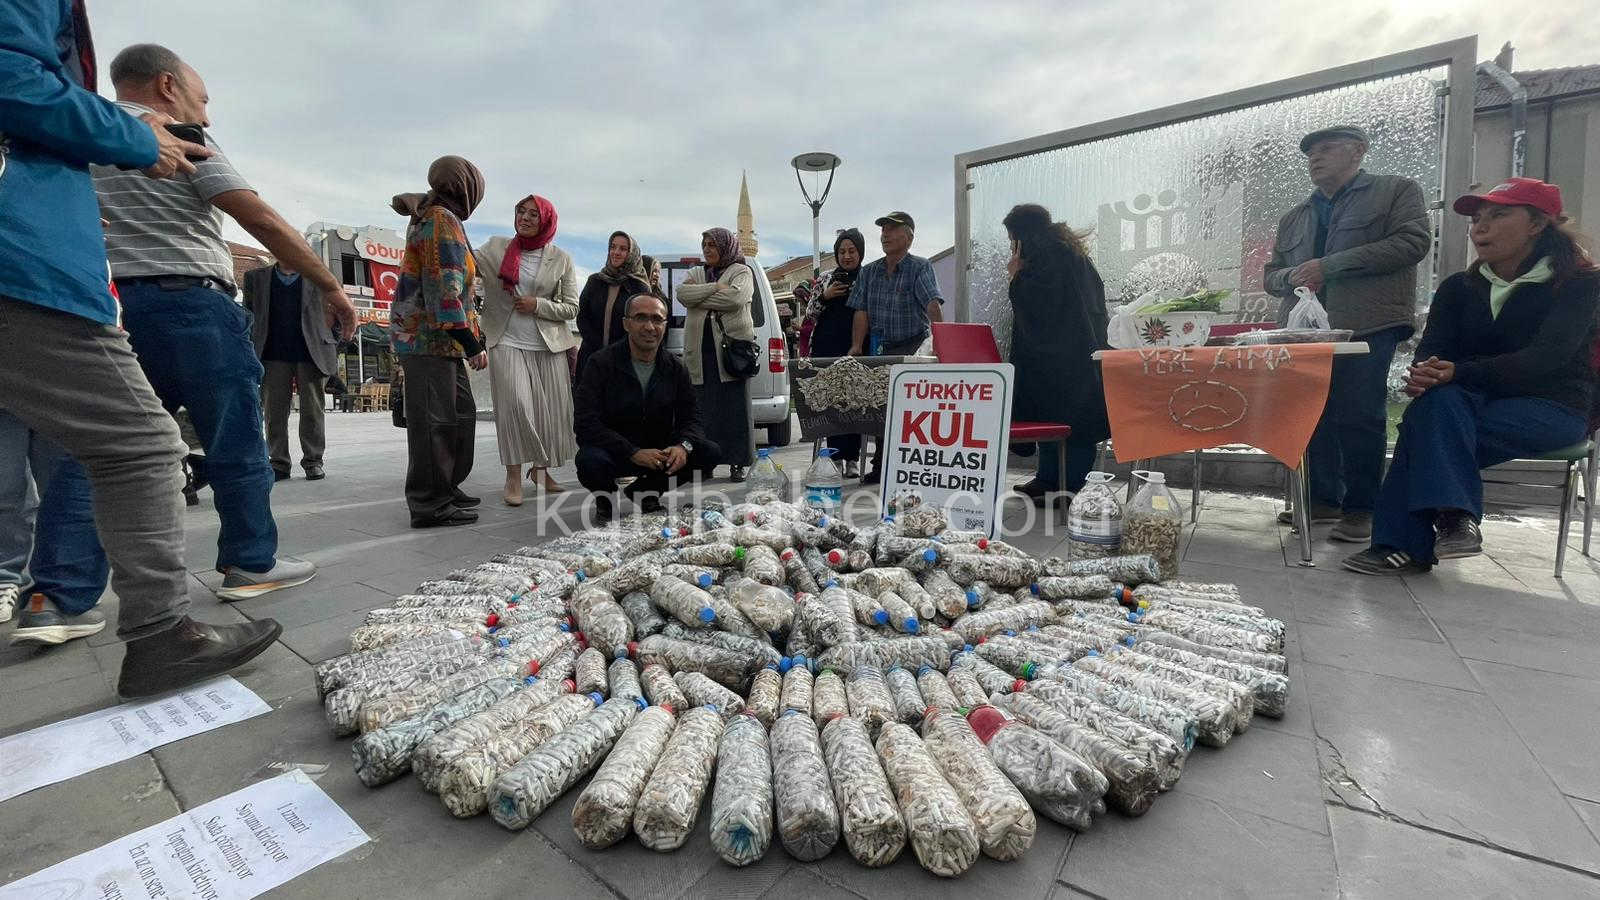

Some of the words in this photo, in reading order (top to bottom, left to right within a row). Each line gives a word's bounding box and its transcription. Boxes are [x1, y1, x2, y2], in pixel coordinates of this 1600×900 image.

[1138, 348, 1194, 374] YERE
[1212, 346, 1292, 371] ATMA
[903, 380, 993, 401] TÜRKİYE
[901, 403, 988, 449] KÜL
[898, 448, 987, 471] TABLASI
